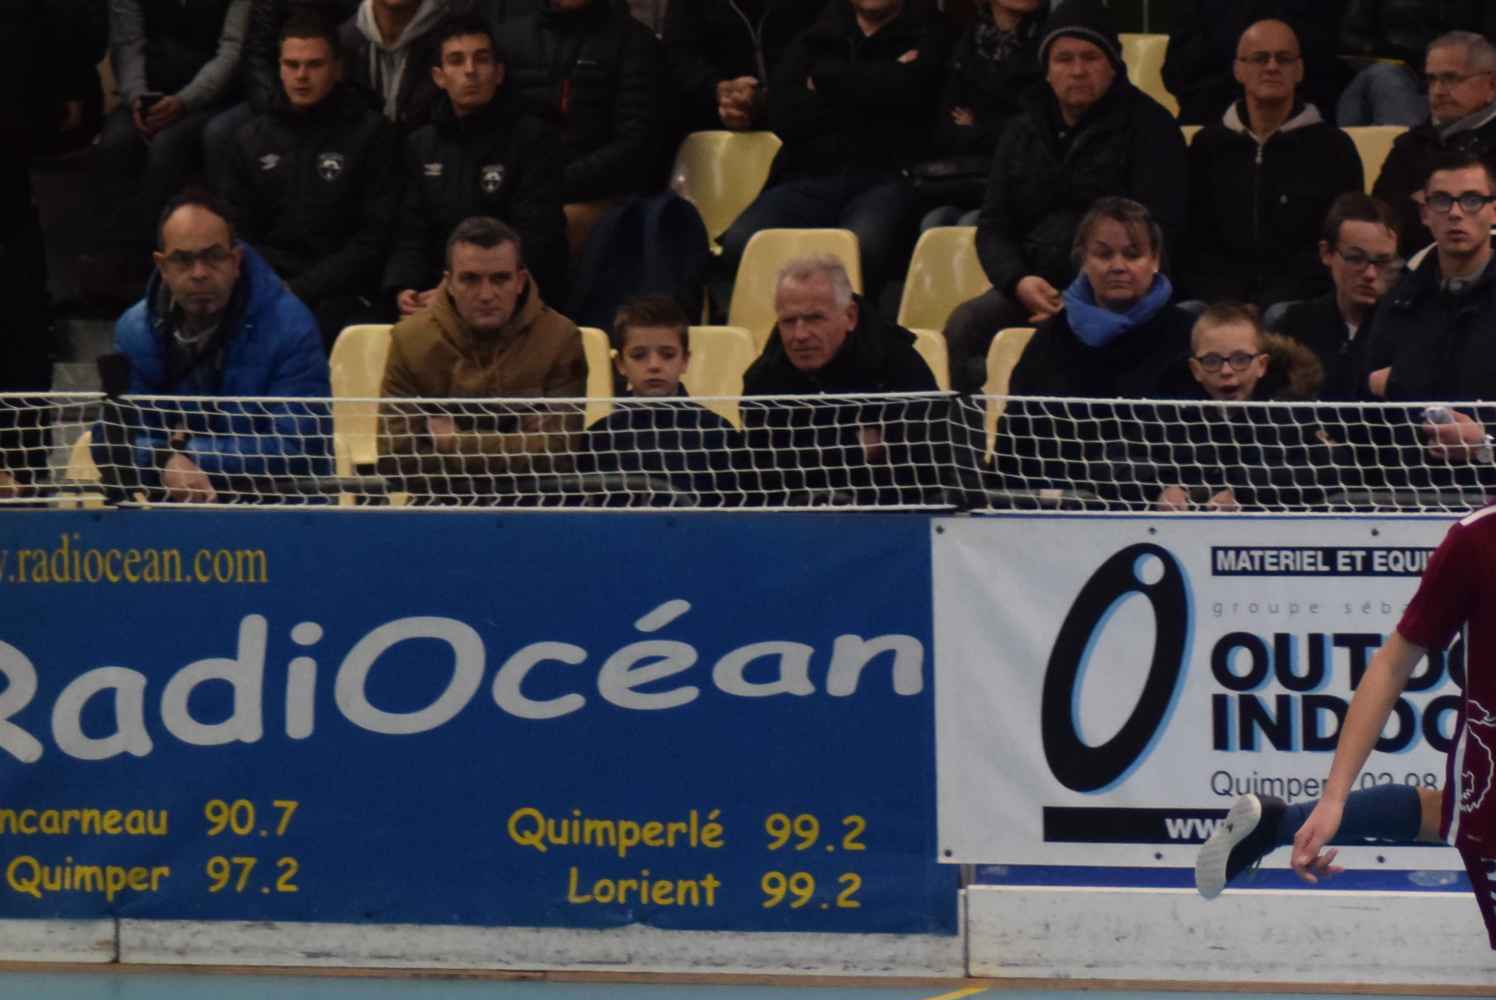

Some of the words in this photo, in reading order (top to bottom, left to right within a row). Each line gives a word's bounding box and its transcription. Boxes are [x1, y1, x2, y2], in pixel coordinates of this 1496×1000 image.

[1217, 550, 1329, 571] MATERIEL
[1337, 550, 1365, 571] ET
[1373, 550, 1435, 572] EQUI
[1212, 600, 1320, 617] groupe
[204, 799, 299, 836] 90.7
[507, 808, 726, 857] Quimperlé
[765, 813, 867, 851] 99.2
[6, 855, 171, 901] Quimper
[206, 856, 300, 893] 97.2
[567, 866, 721, 906] Lorient
[760, 871, 862, 909] 99.2
